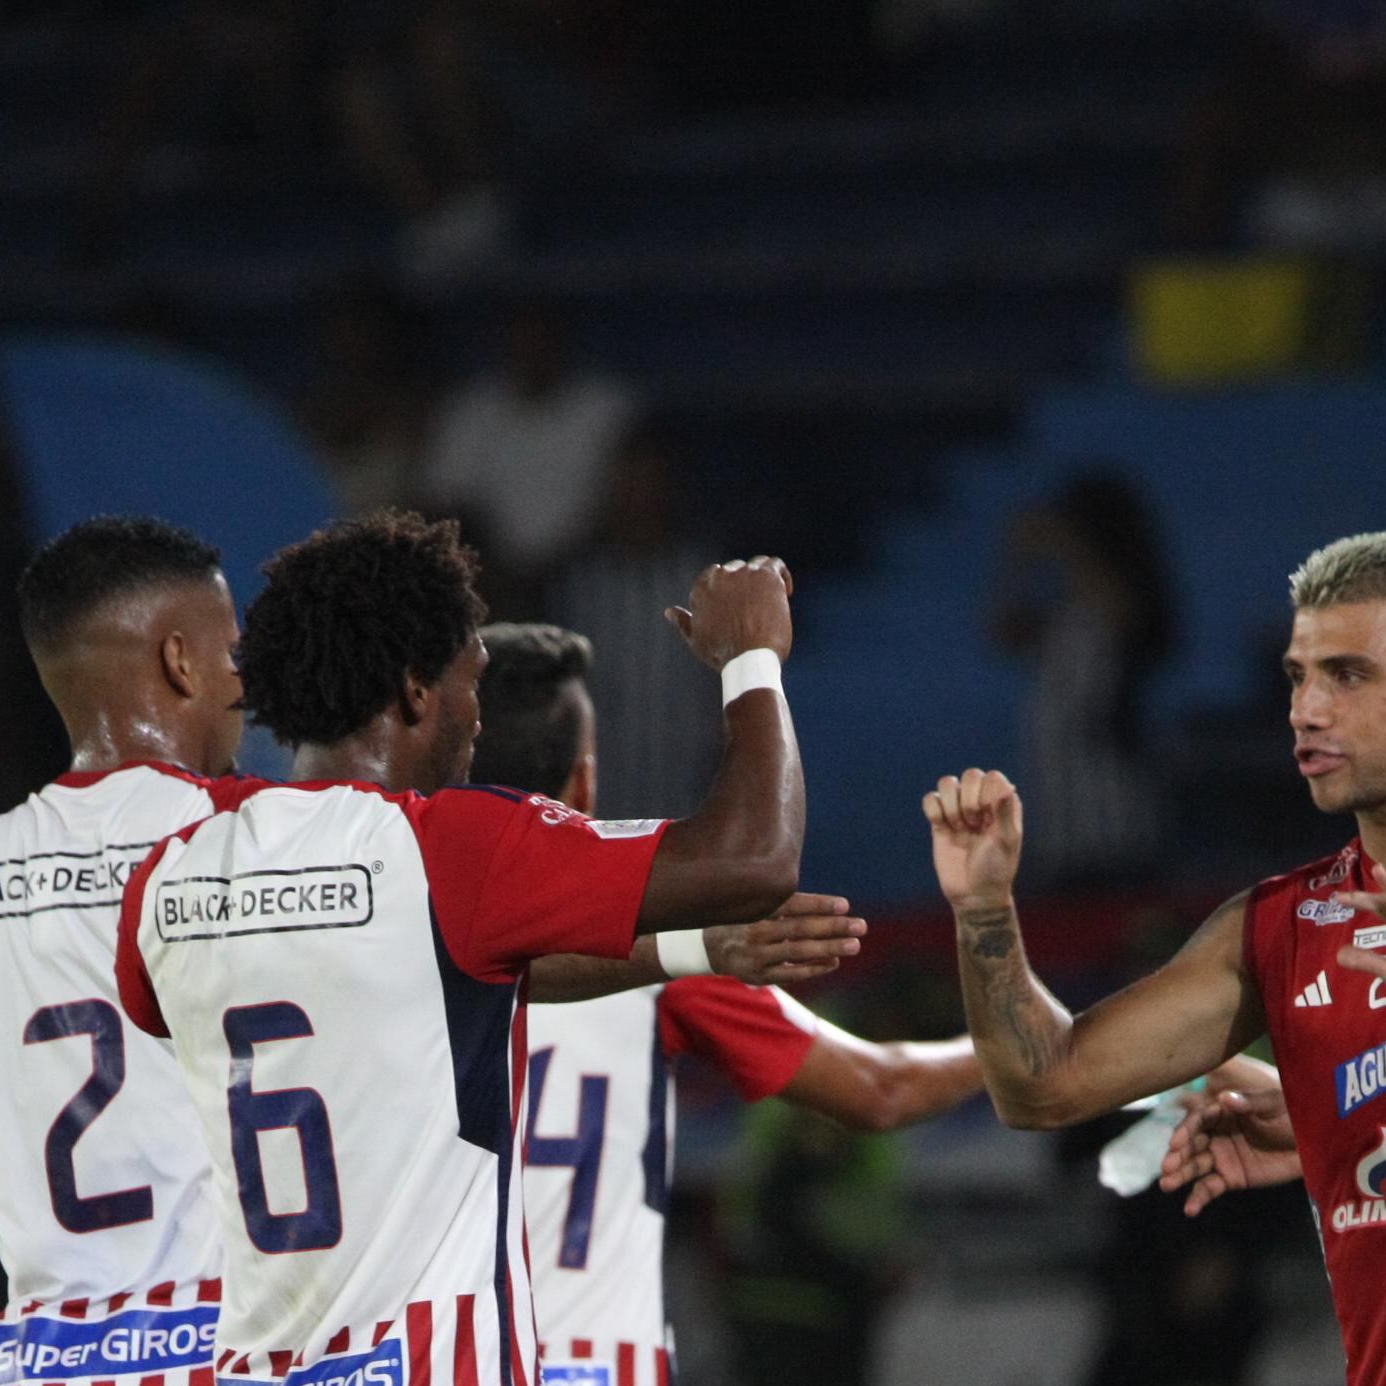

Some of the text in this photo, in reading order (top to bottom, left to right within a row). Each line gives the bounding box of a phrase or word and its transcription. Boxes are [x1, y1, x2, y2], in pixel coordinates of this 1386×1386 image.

[163, 883, 359, 926] BLACK+DECKER
[24, 1000, 154, 1234] 2
[223, 1001, 343, 1254] 6
